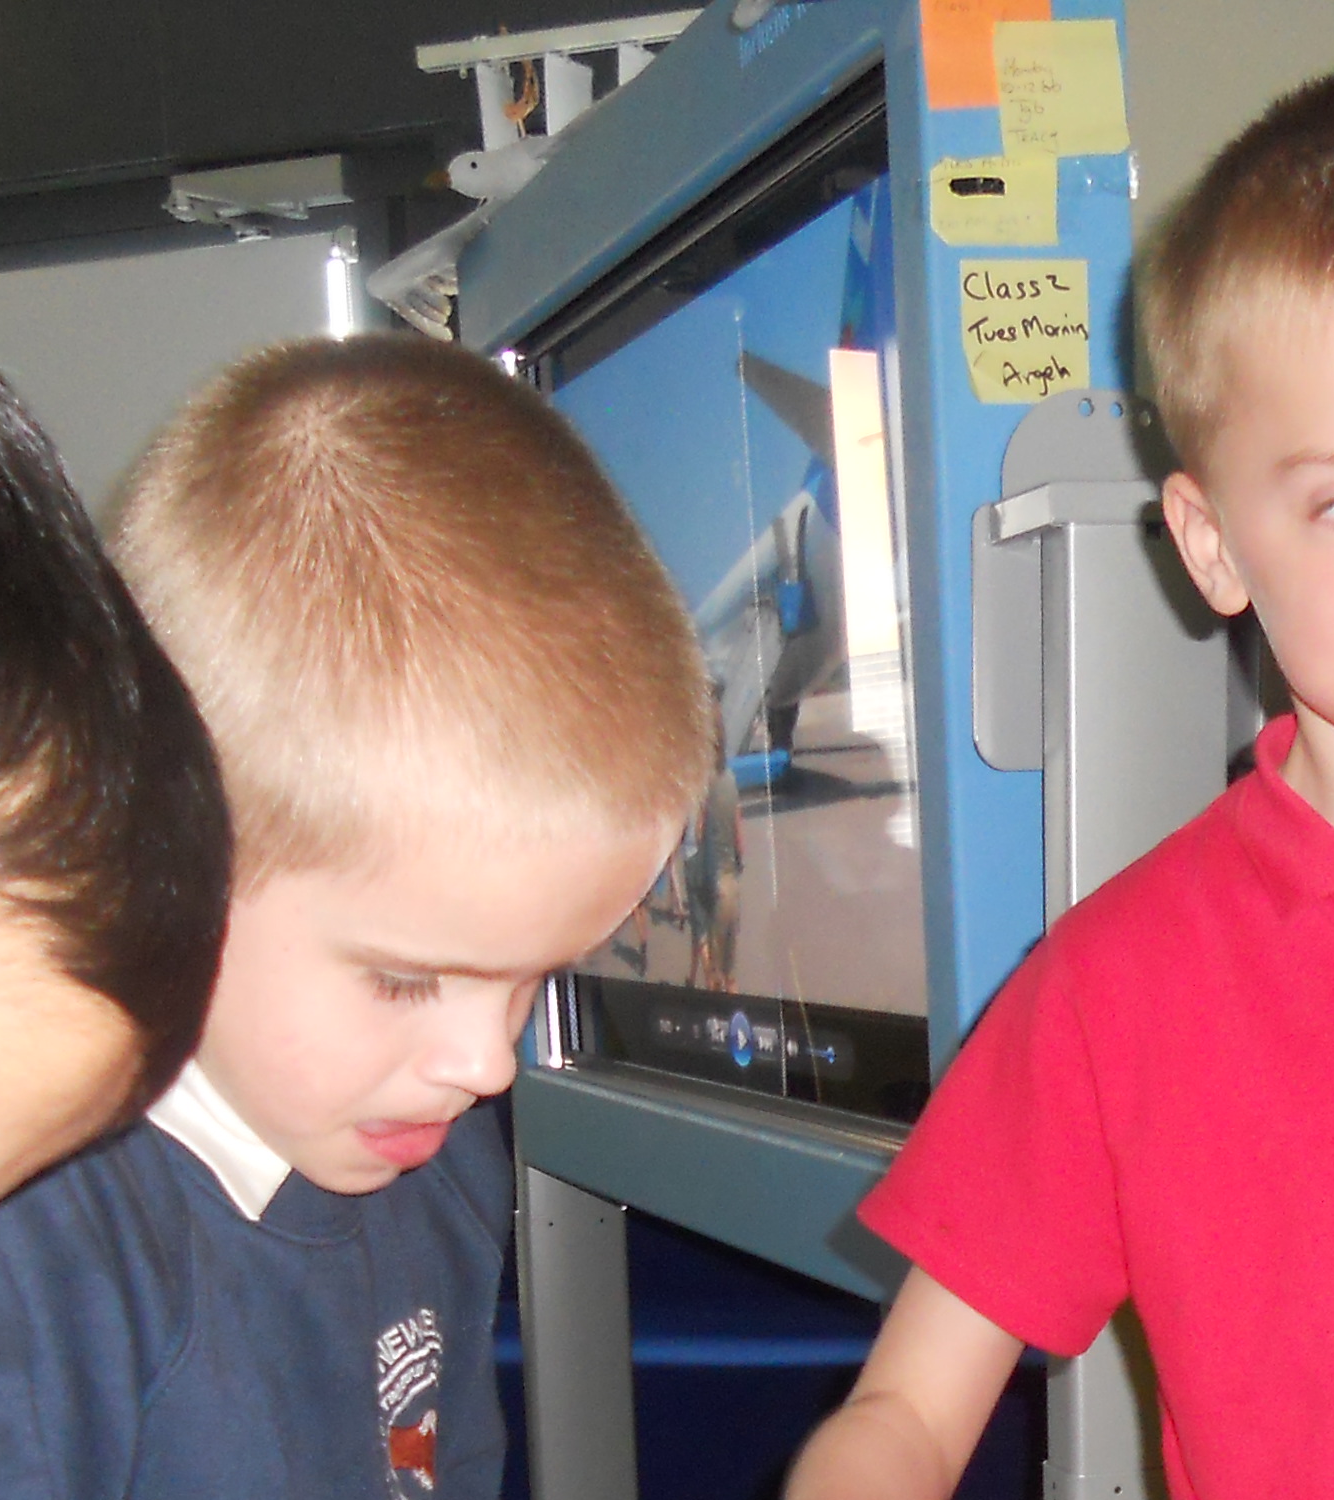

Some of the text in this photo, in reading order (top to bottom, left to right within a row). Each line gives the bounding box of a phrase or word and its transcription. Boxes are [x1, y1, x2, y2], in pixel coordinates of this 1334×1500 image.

[963, 271, 1070, 300] Class 2
[967, 316, 1017, 344] Tues
